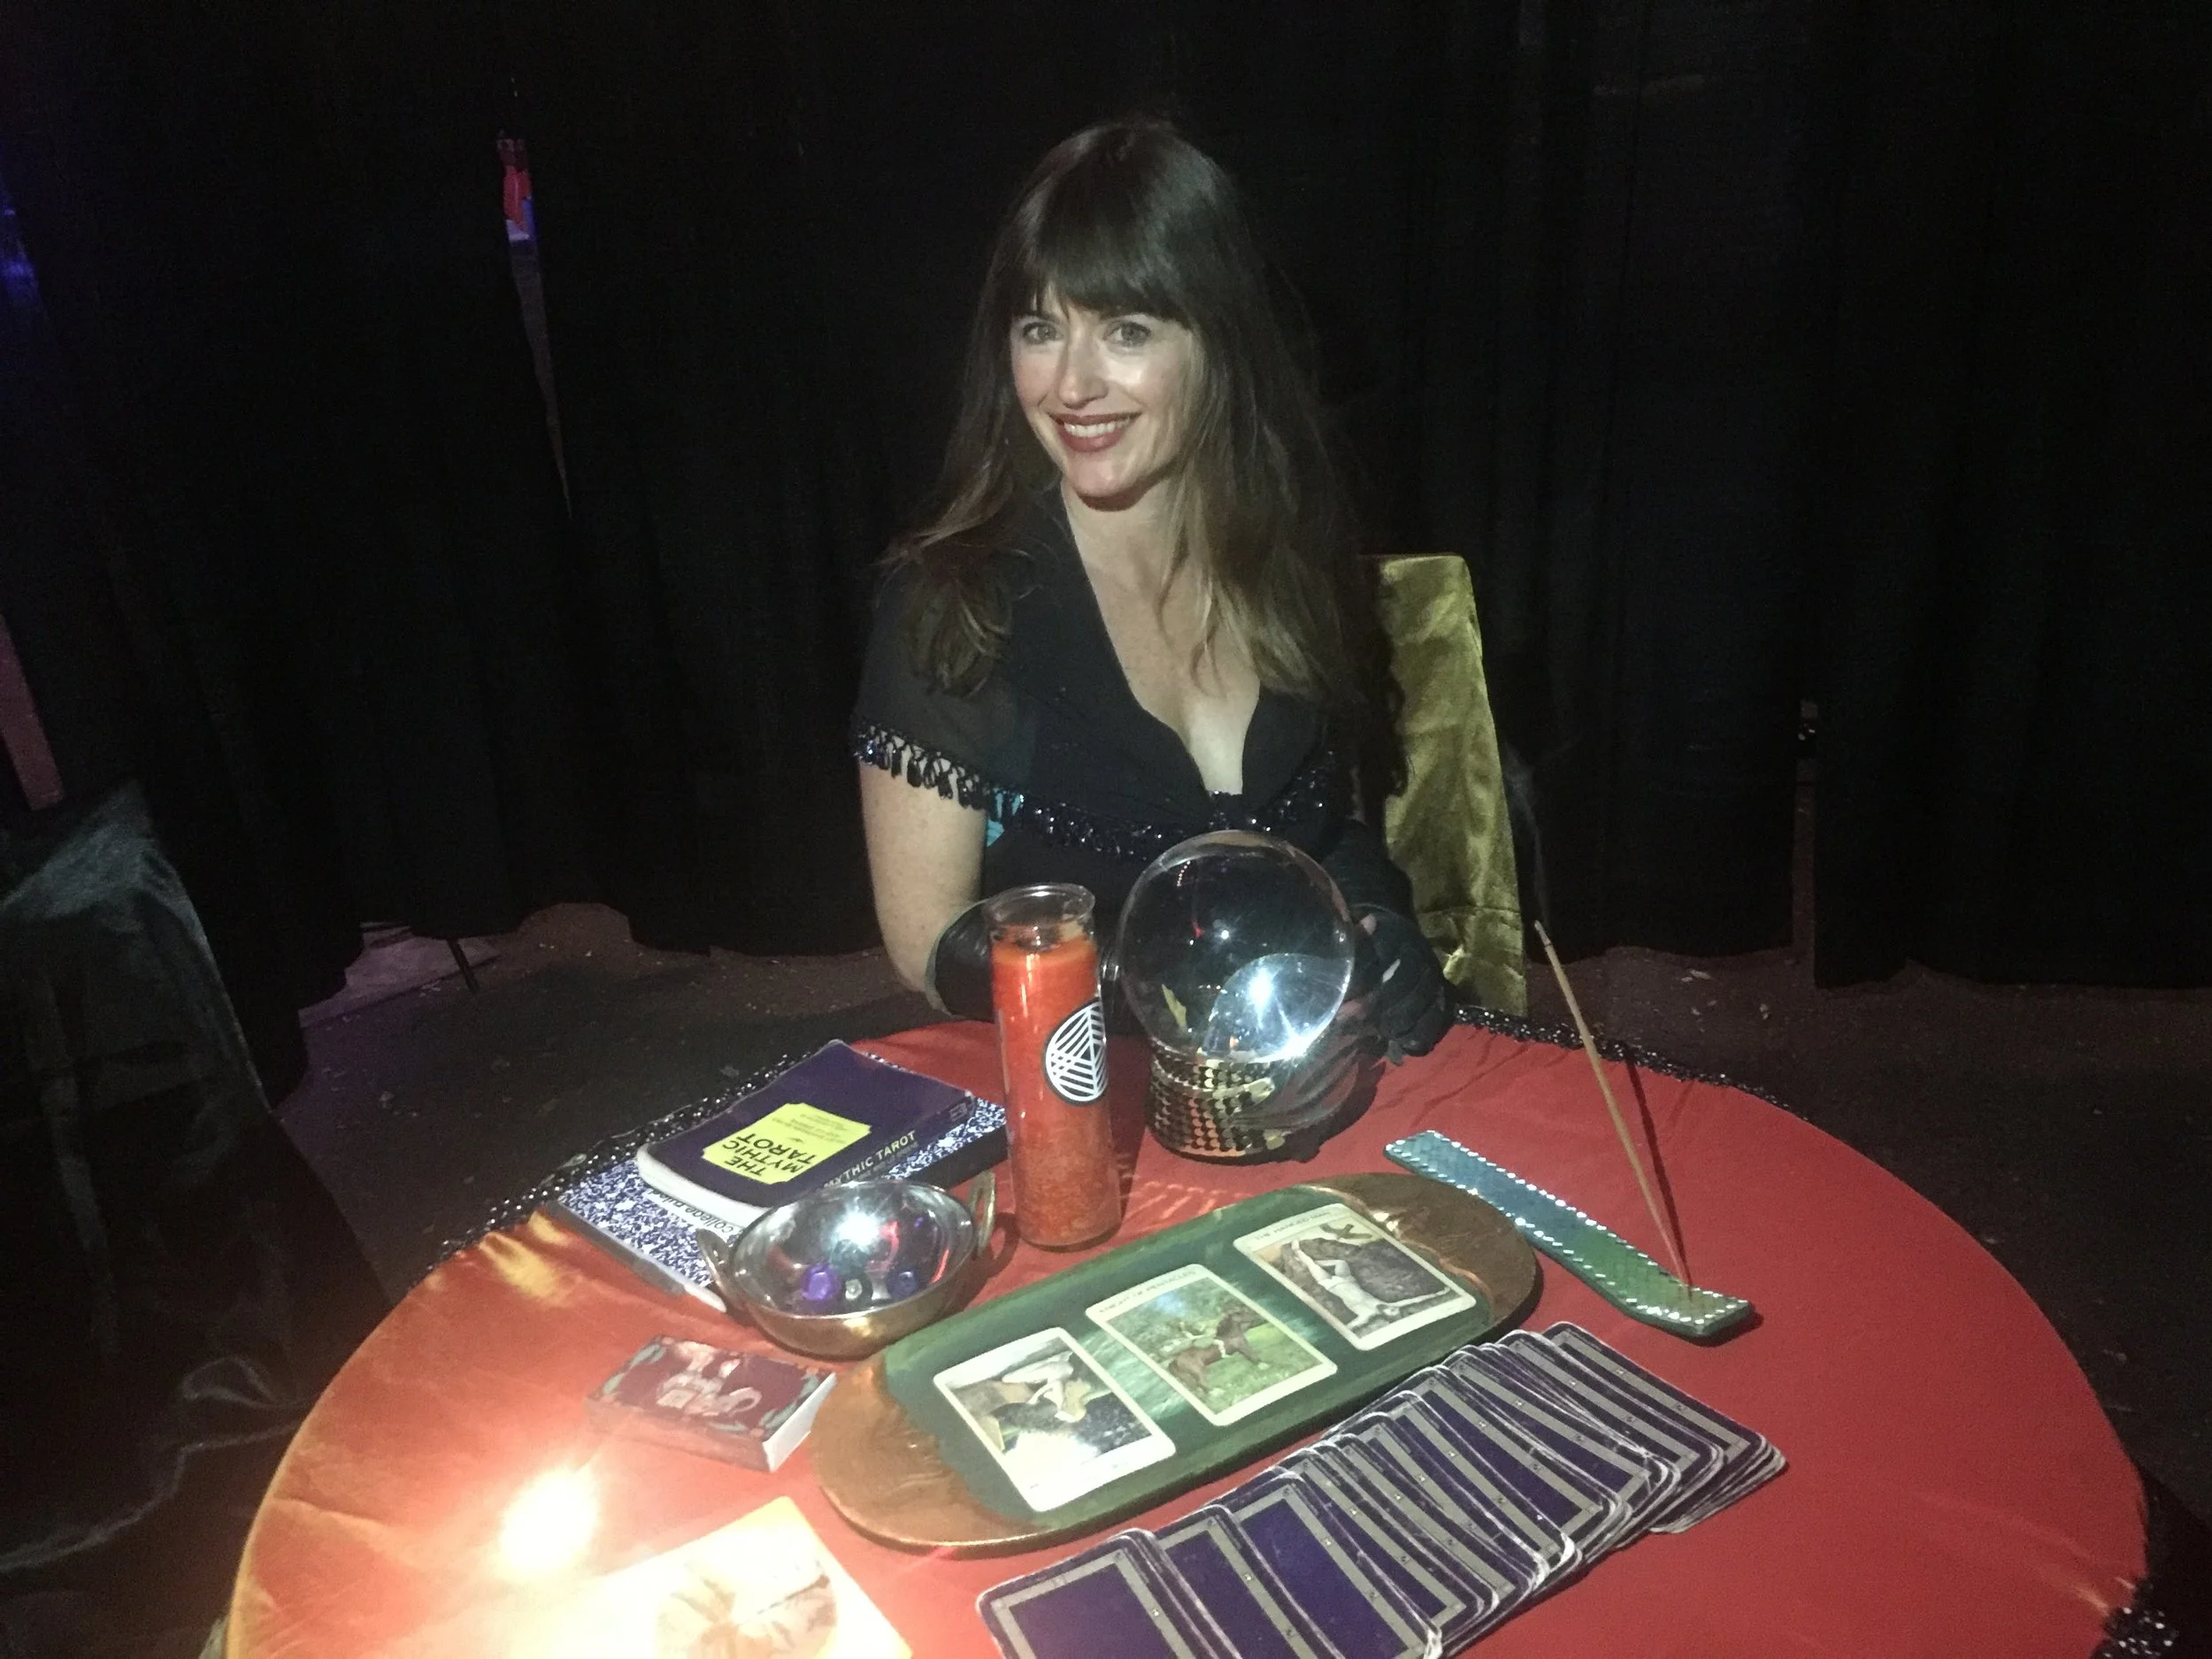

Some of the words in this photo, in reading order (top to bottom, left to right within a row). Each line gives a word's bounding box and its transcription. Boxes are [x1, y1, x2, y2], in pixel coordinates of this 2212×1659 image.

[722, 1140, 803, 1173] MYTHIC
[736, 1133, 817, 1164] TAROT
[824, 1156, 874, 1187] MYTHIC
[875, 1129, 916, 1161] TAROT
[724, 1155, 766, 1176] THE
